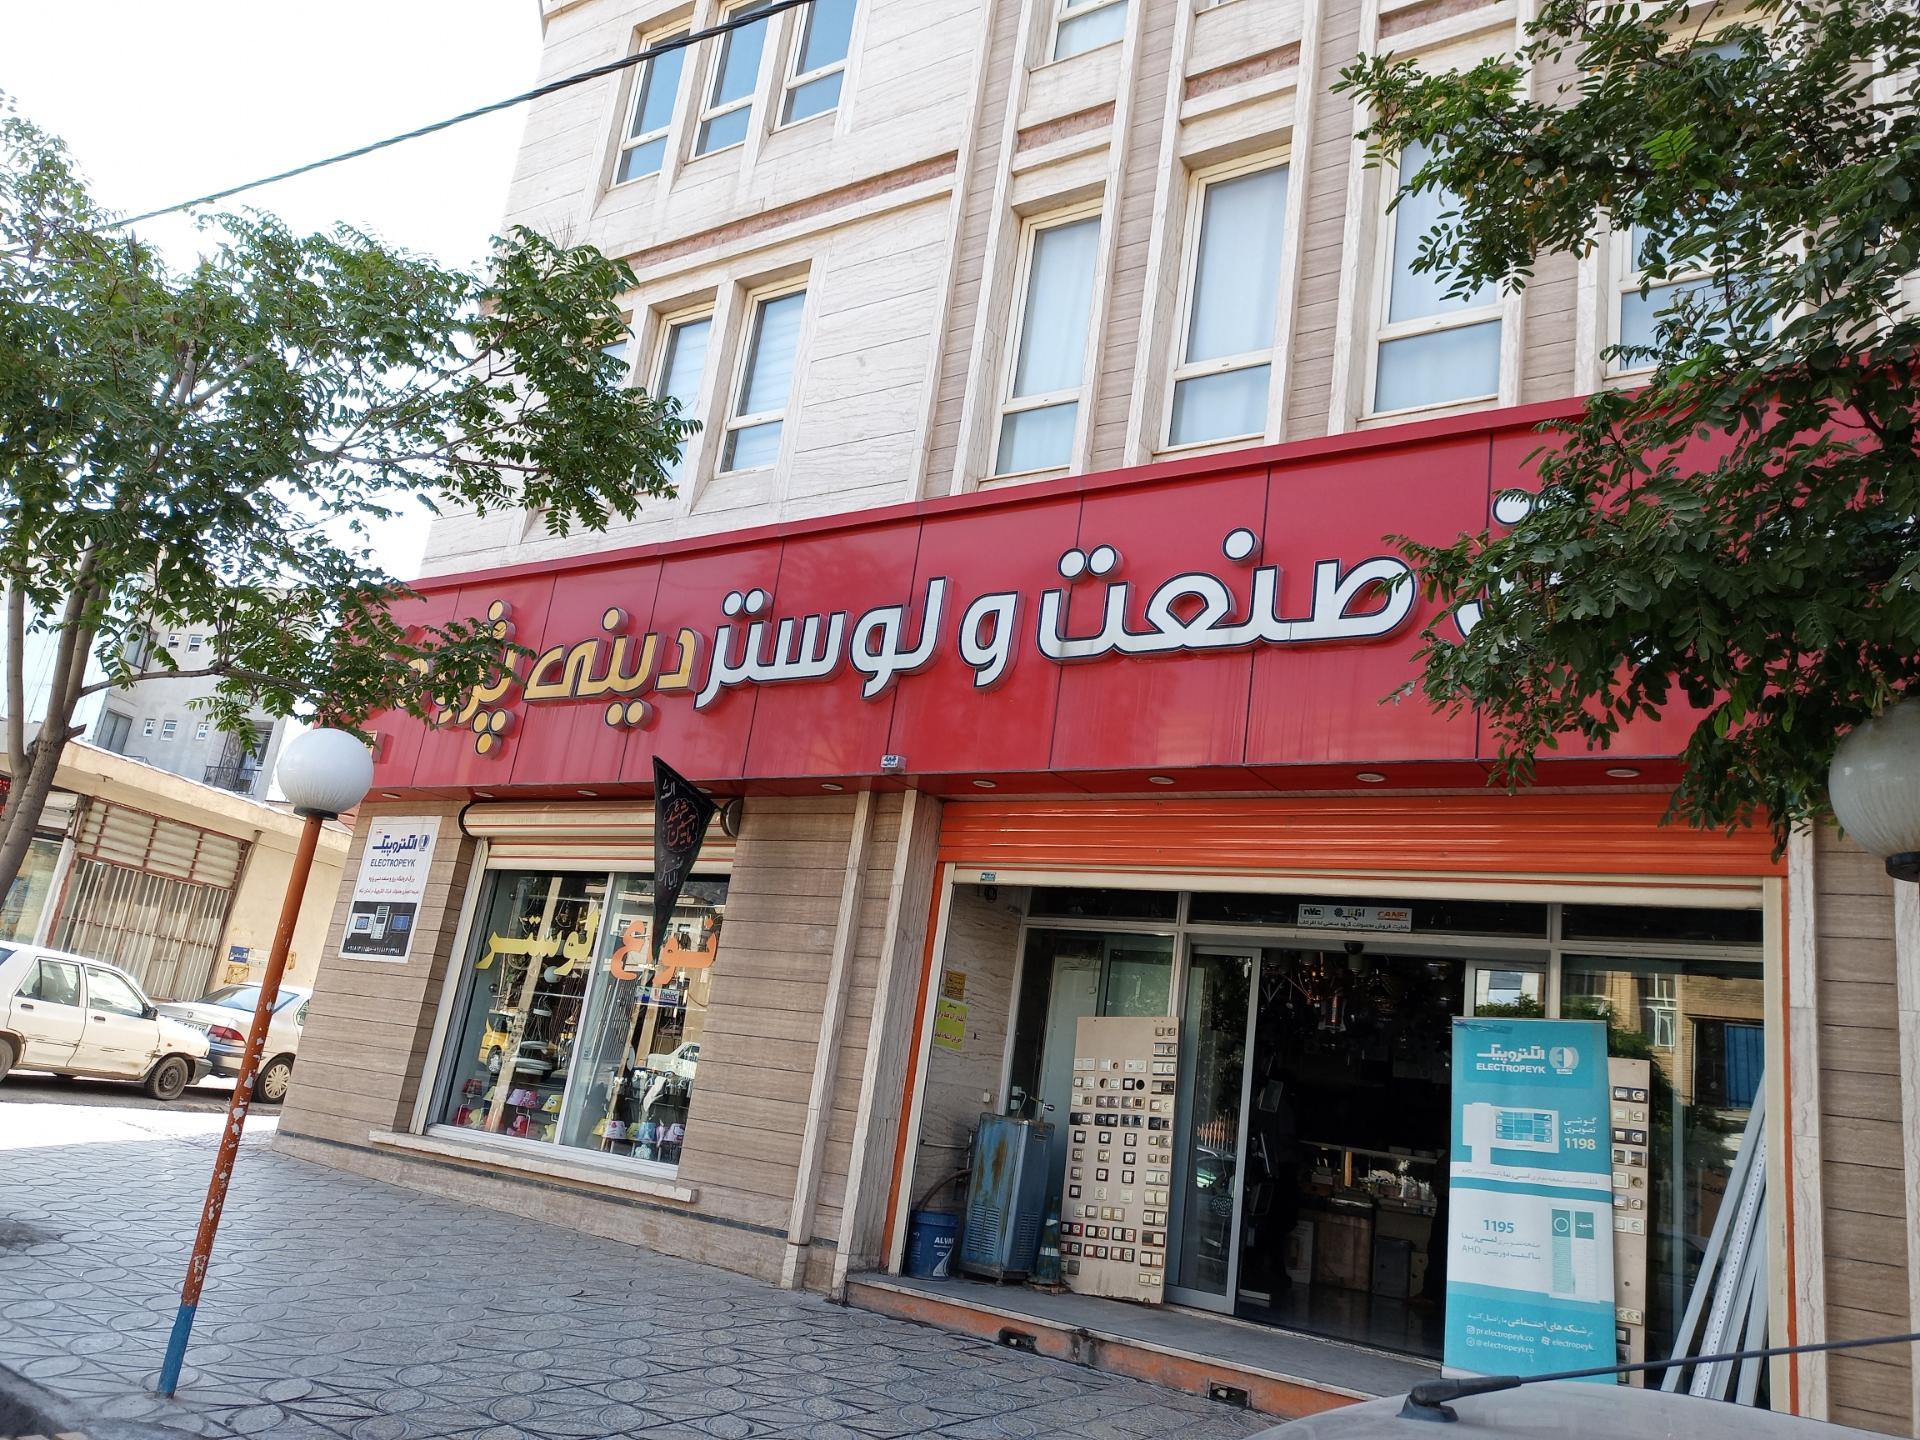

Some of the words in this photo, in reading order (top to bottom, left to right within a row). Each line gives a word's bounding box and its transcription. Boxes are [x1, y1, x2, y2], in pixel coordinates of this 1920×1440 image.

[1036, 527, 1418, 664] صنعت
[692, 575, 951, 711] لوستر
[958, 589, 1023, 690] و
[521, 606, 699, 730] دینی
[370, 858, 416, 868] ELECTROPEYK
[474, 897, 600, 977] لوستر
[1476, 1044, 1545, 1064] الکتروپیک
[1476, 1063, 1546, 1074] ELECTROPEYK
[1563, 1116, 1597, 1126] گوشی
[1563, 1126, 1596, 1135] تصویری
[1564, 1137, 1597, 1151] 1198
[1483, 1219, 1515, 1233] 1195
[1462, 1245, 1481, 1254] AHD
